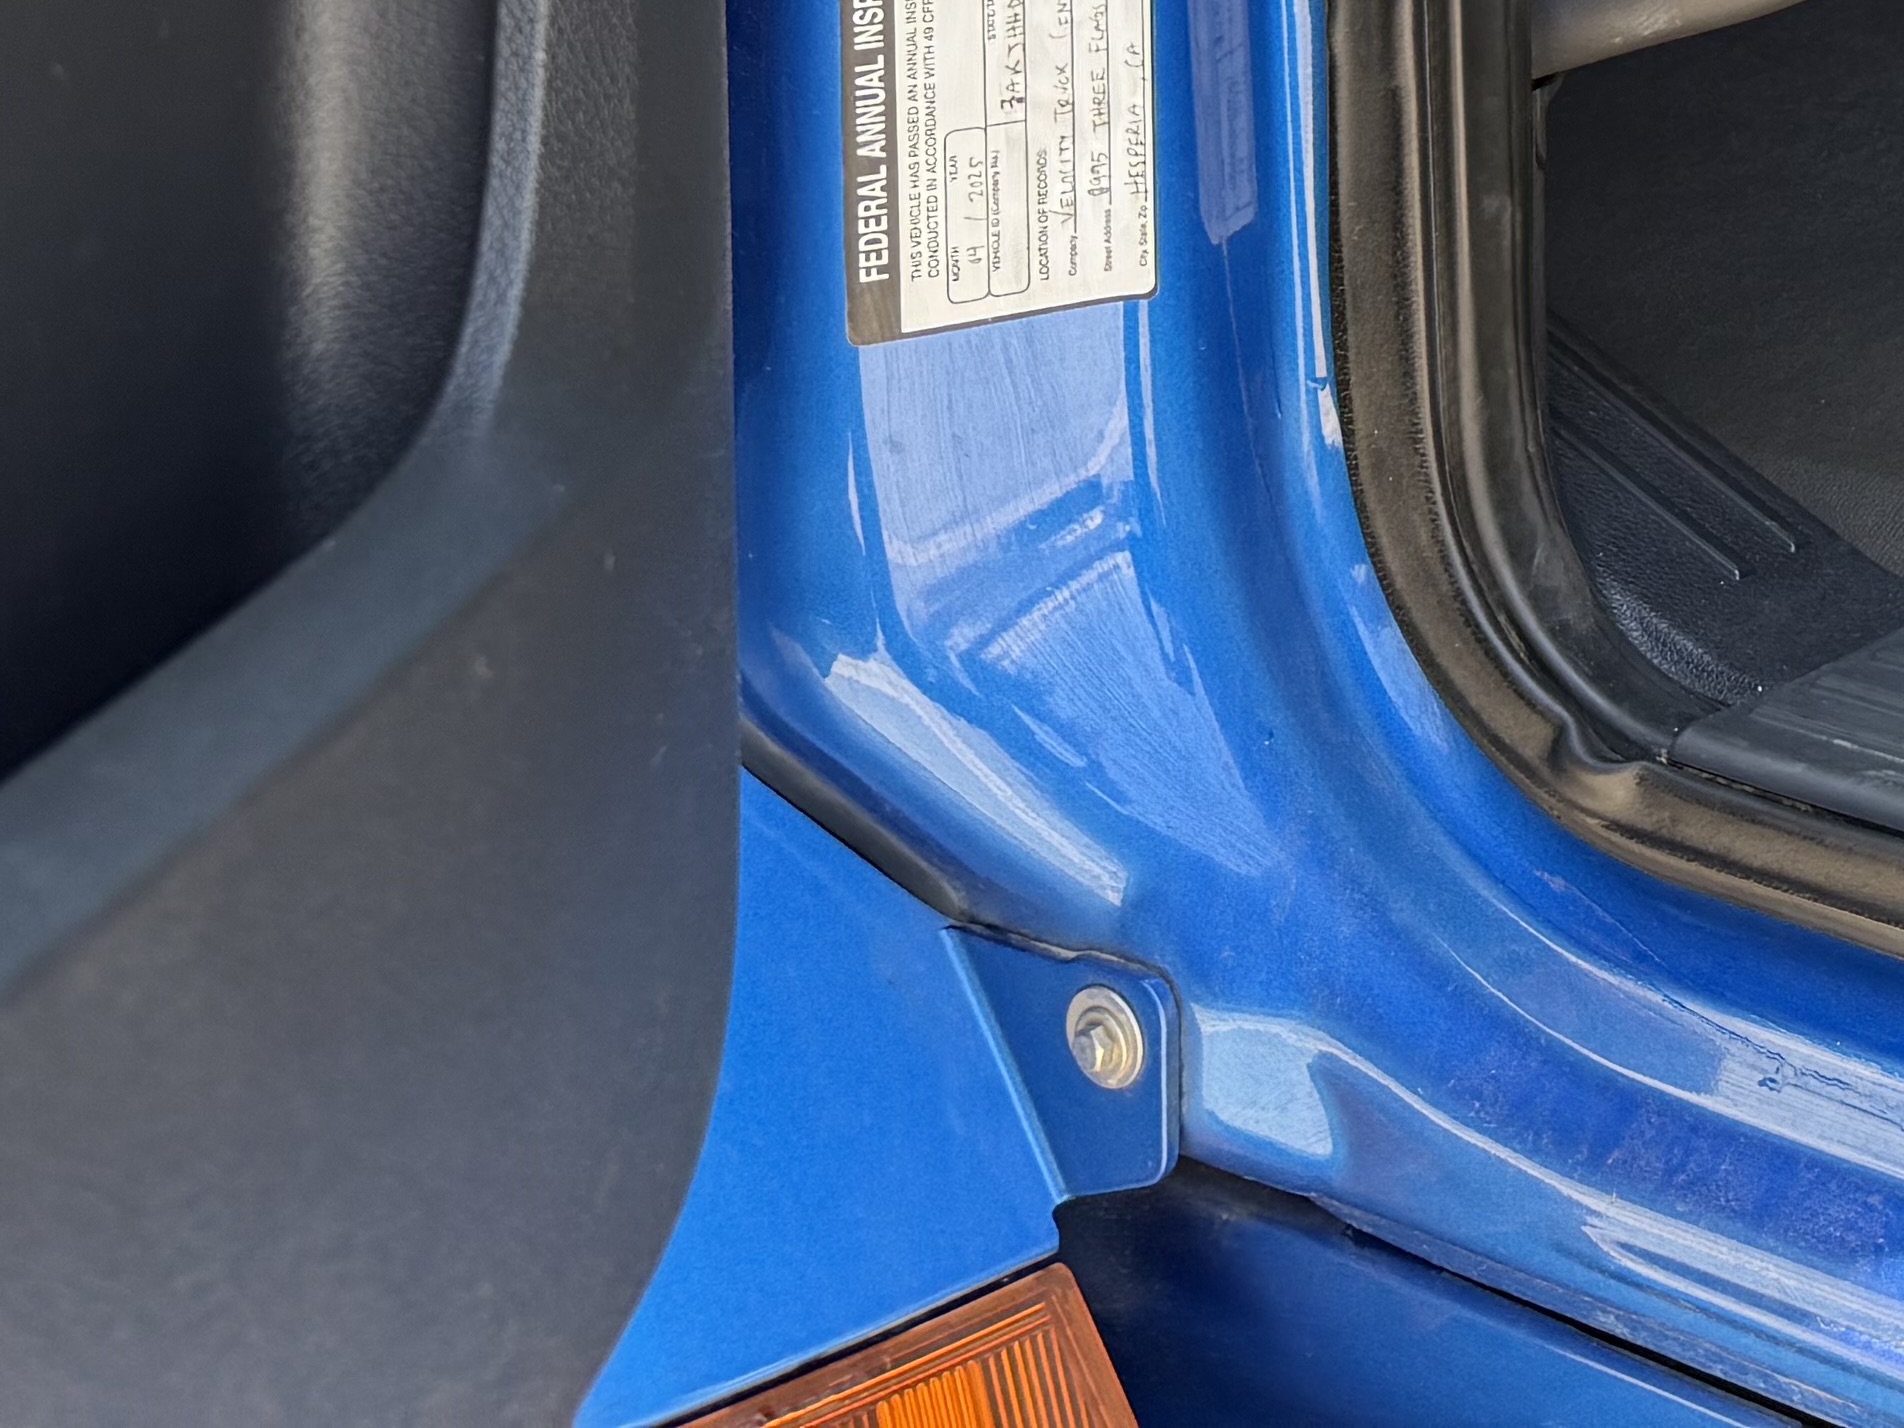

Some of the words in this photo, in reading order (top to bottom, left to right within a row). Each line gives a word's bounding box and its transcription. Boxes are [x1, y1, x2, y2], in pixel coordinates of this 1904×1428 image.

[923, 27, 934, 41] 49
[1087, 4, 1107, 54] FLAGS
[905, 27, 918, 80] ANNUAL
[923, 45, 935, 78] WITH
[854, 55, 887, 157] ANNUAL
[907, 84, 918, 102] AN
[1090, 68, 1109, 133] THREE
[907, 107, 920, 157] PASSED
[924, 83, 937, 173] ACCORDANCE
[909, 162, 920, 188] HAS
[926, 178, 937, 190] IN
[949, 155, 958, 183] YEAR
[968, 157, 984, 202] 2025
[1049, 135, 1074, 225] VELOCITY
[857, 165, 889, 282] FEDERAL
[909, 192, 921, 248] VEHICLE
[991, 219, 1000, 227] ID
[1038, 208, 1048, 222] OF
[1103, 209, 1112, 244] Address
[928, 195, 939, 278] CONDUCTED
[966, 245, 984, 264] 04
[992, 230, 1001, 272] VEHICLE
[1039, 225, 1049, 280] LOCATION
[1068, 235, 1078, 276] Company
[911, 251, 922, 282] THIS
[951, 246, 960, 281] MONTH
[1103, 246, 1112, 272] Street
